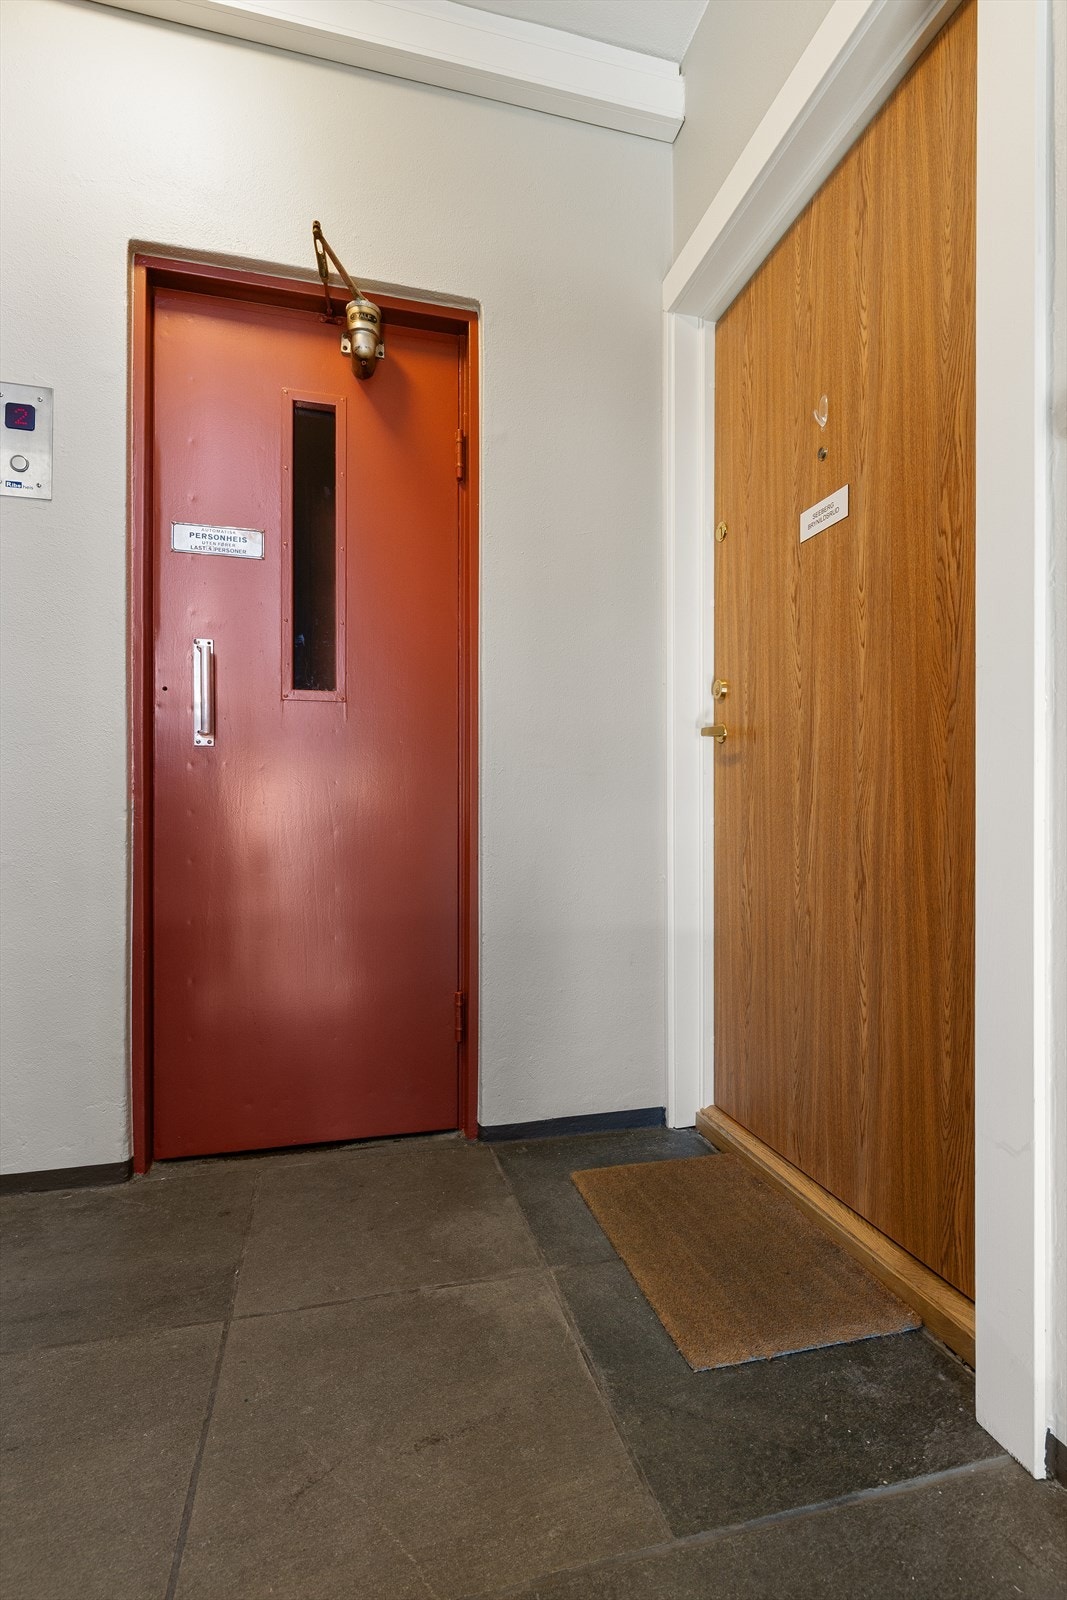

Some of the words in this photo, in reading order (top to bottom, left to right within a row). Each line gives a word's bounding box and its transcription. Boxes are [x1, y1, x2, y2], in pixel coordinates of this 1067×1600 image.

[14, 407, 28, 425] 2
[812, 502, 834, 519] SEEBERG
[189, 532, 248, 543] PERSONHEIS
